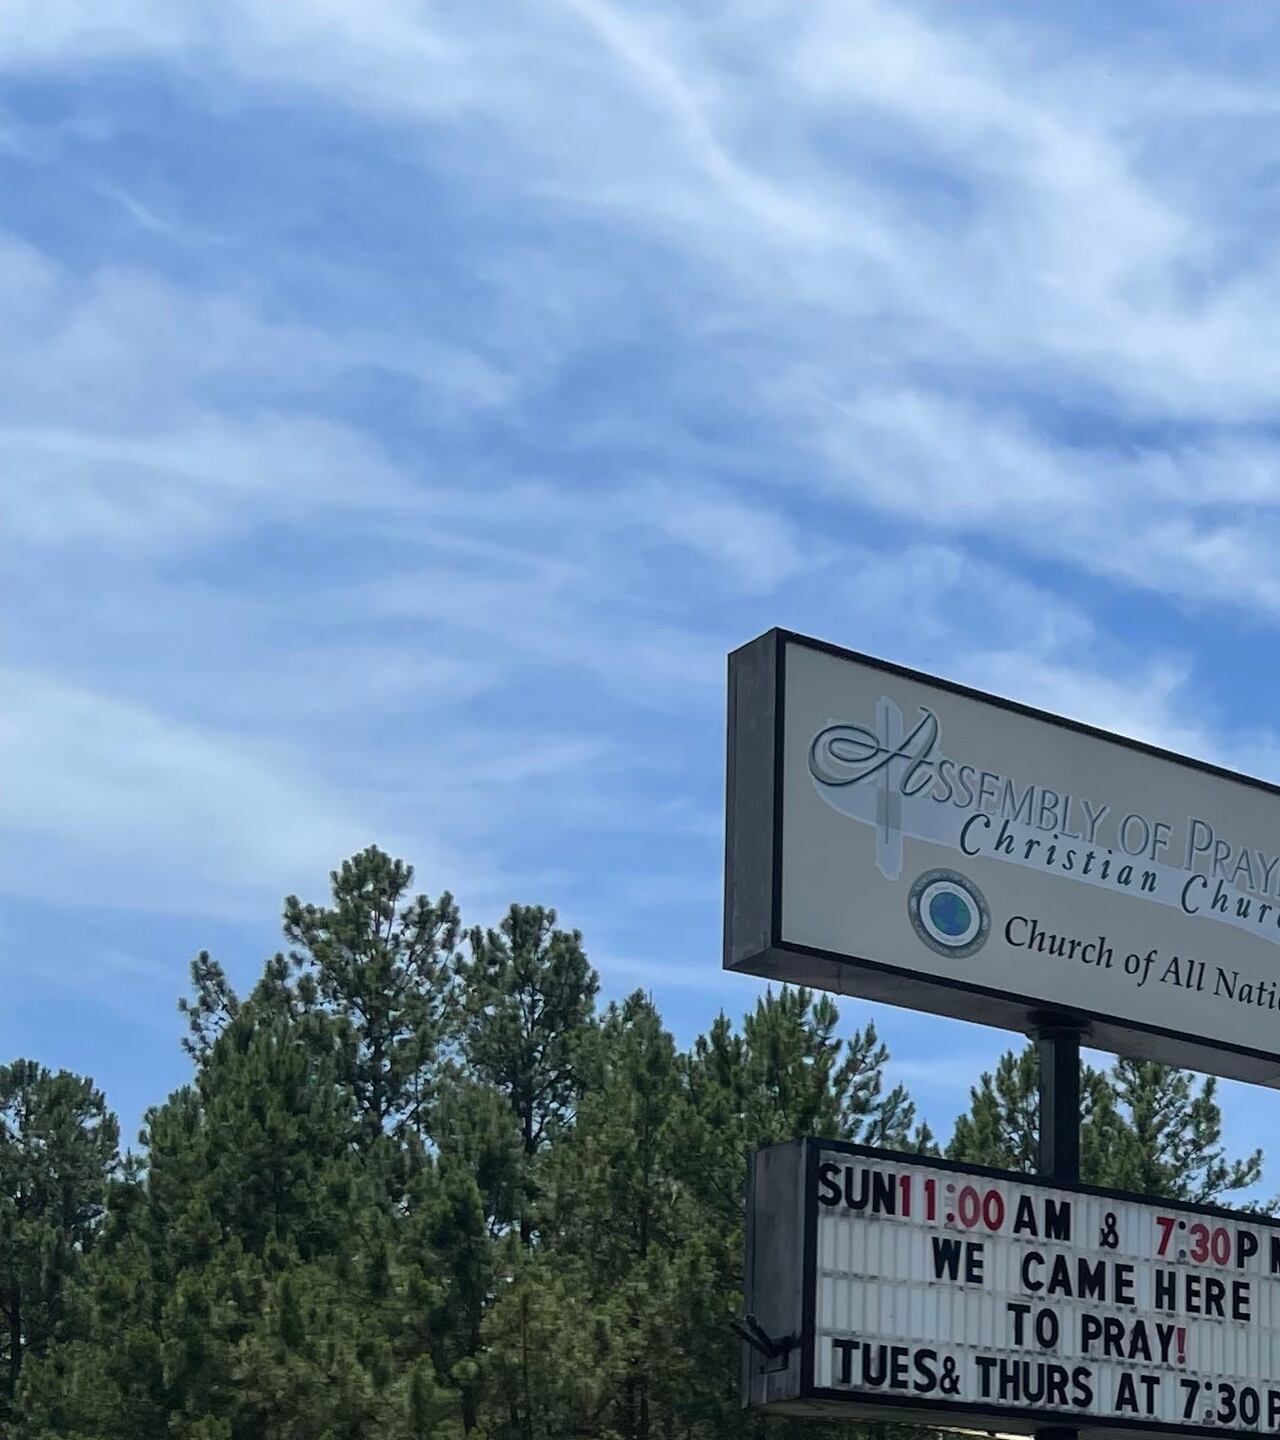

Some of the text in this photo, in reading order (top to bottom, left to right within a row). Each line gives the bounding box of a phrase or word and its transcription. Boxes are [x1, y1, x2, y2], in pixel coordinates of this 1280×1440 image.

[809, 706, 1108, 843] ASSEMBLY
[1120, 813, 1172, 861] OF
[960, 813, 1157, 893] Christian
[1004, 916, 1113, 969] Church
[1124, 950, 1158, 987] of
[1159, 956, 1206, 992] All
[1100, 1212, 1120, 1249] &
[932, 1236, 1252, 1321] WE CAME HERE
[1007, 1303, 1186, 1364] TO PRAY!
[975, 1356, 1093, 1408] THURS
[1115, 1373, 1160, 1415] AT
[1181, 1378, 1260, 1425] 7:30
